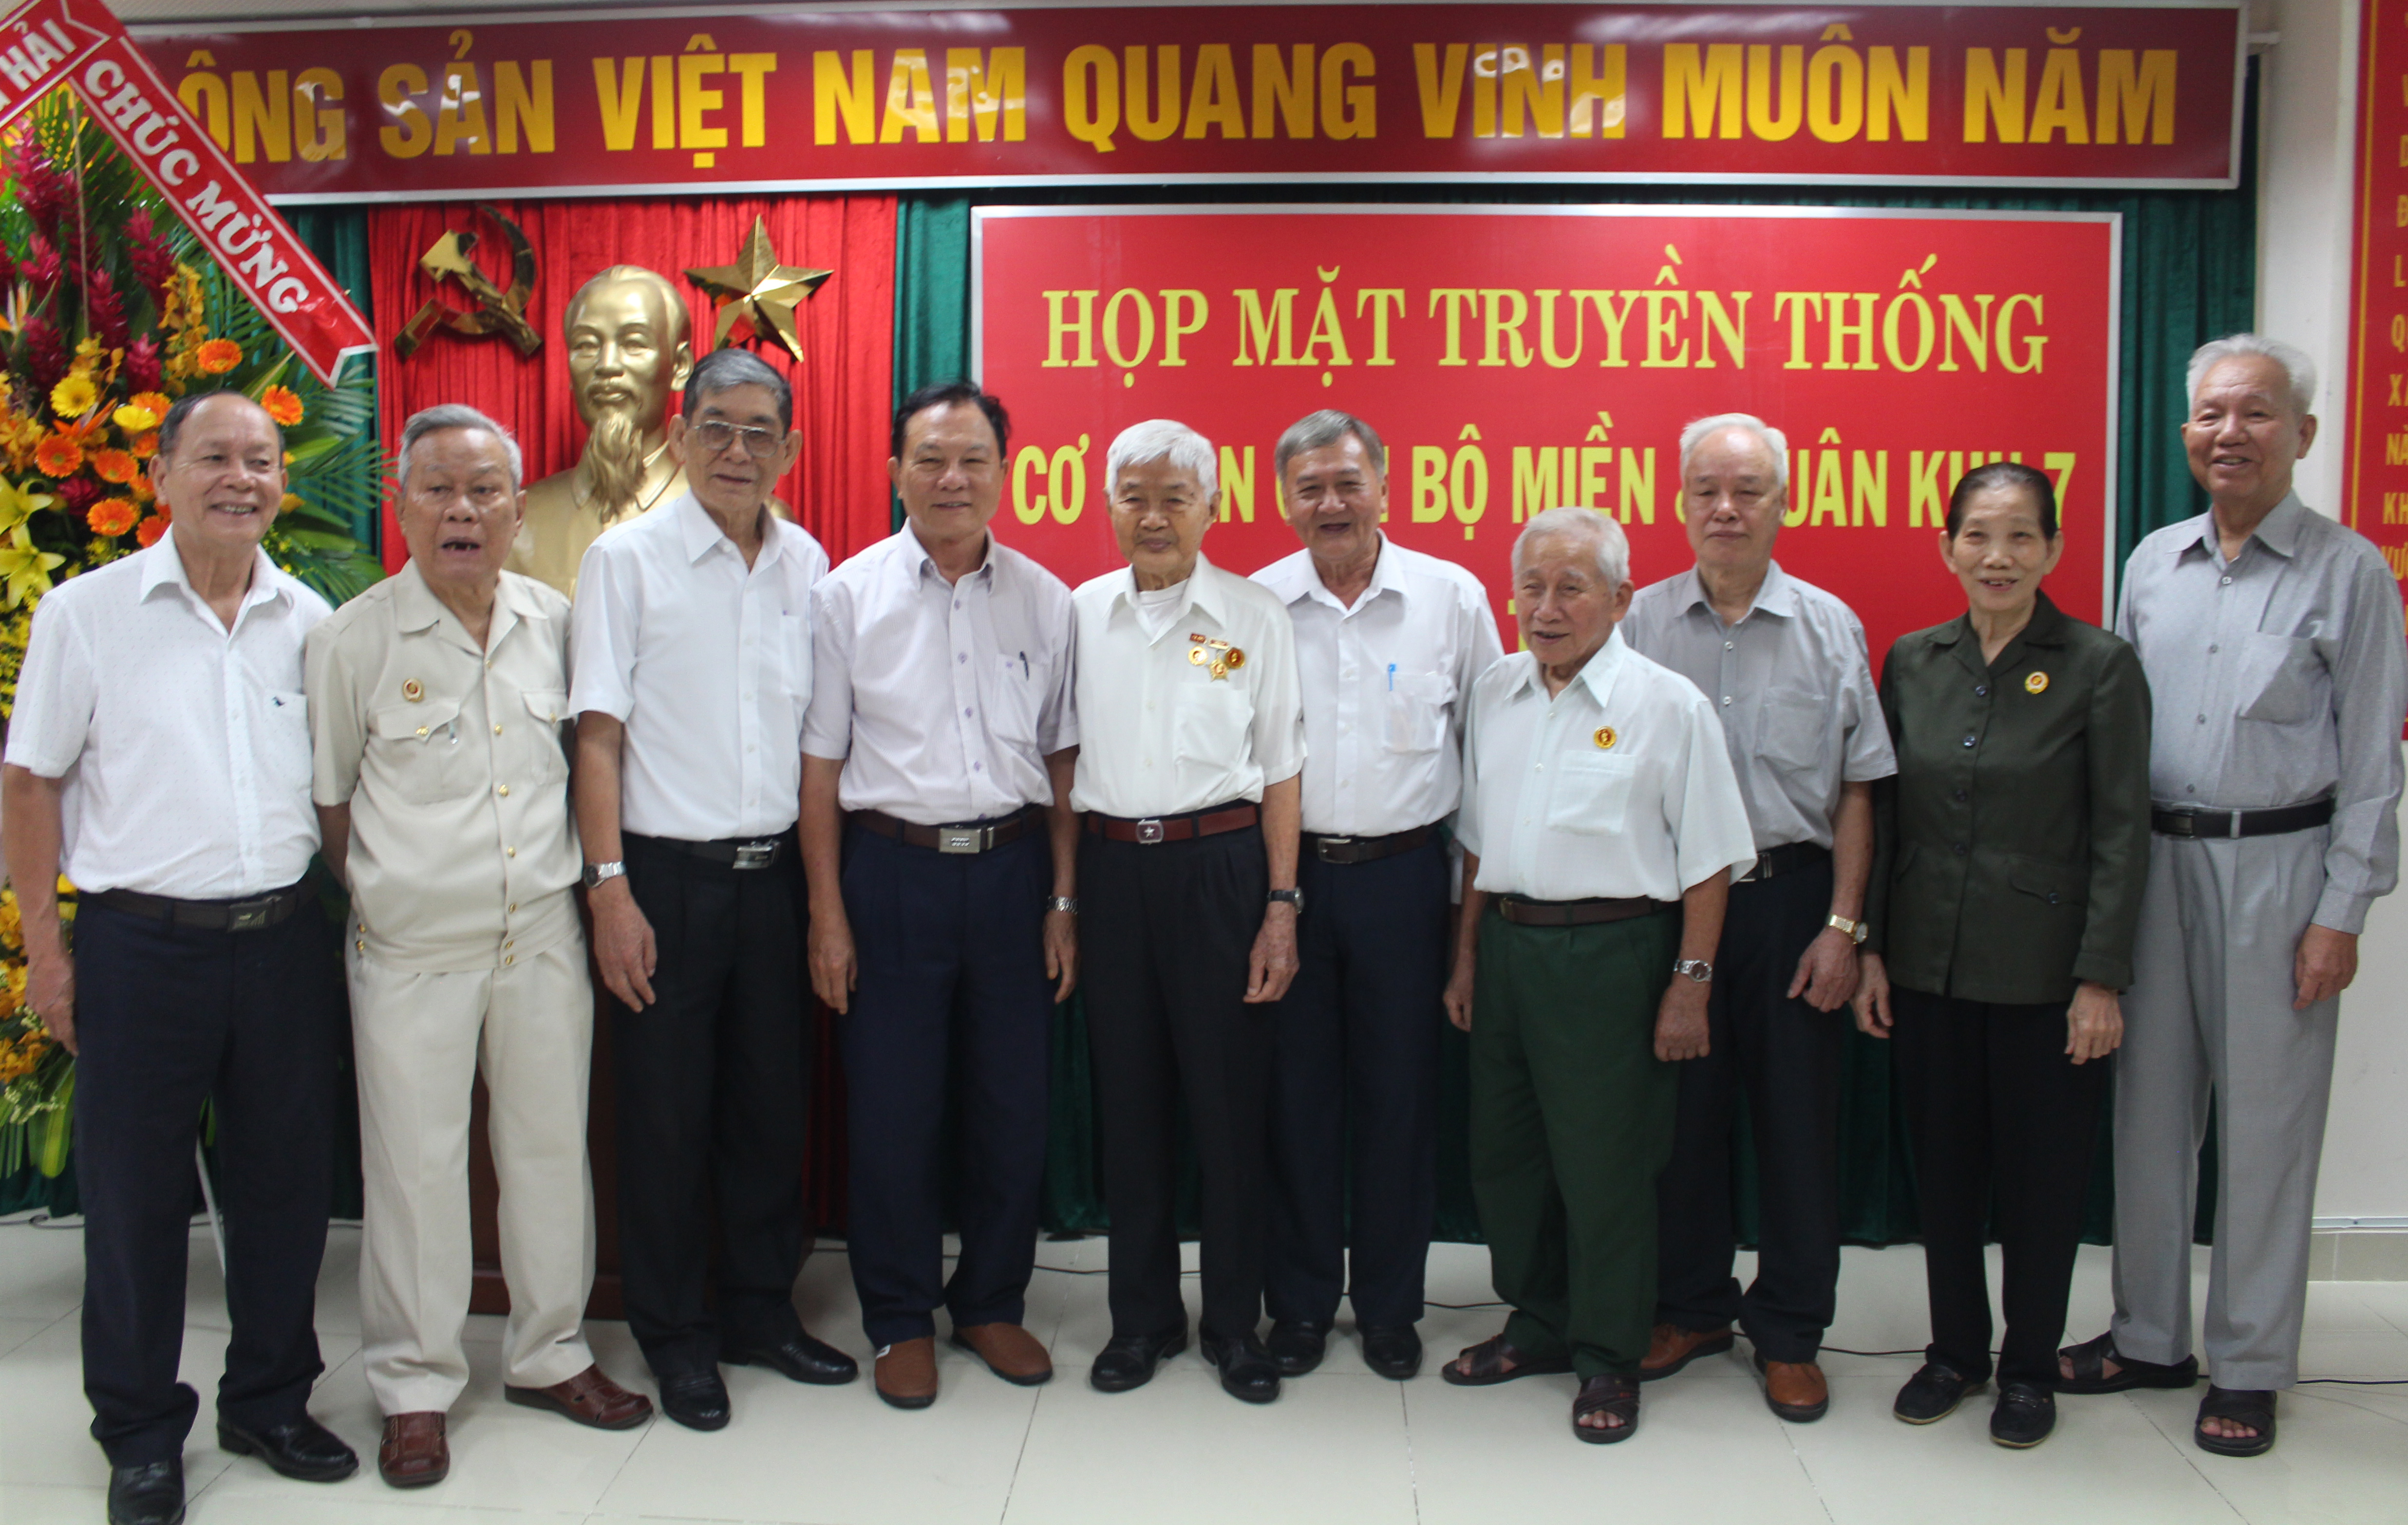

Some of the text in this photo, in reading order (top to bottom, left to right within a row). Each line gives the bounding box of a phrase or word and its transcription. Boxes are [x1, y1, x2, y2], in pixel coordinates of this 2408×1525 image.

[378, 29, 555, 159] SẢN
[592, 34, 777, 168] VIỆT
[813, 46, 1026, 146] NAM
[1063, 42, 1377, 153] QUANG
[1412, 43, 1627, 139] VINH
[1662, 23, 1930, 144] MUÔN
[1963, 26, 2178, 145] NĂM
[84, 59, 310, 314] CHÚC MỪNG
[1041, 243, 2049, 388] HỌP MẶT TRUYỀN THỐNG
[1012, 433, 1090, 525] CƠ
[1412, 424, 1488, 540] BỘ
[1512, 411, 1656, 525] MIỀN
[1784, 427, 1887, 527] UÂN
[2044, 452, 2076, 529] 7
